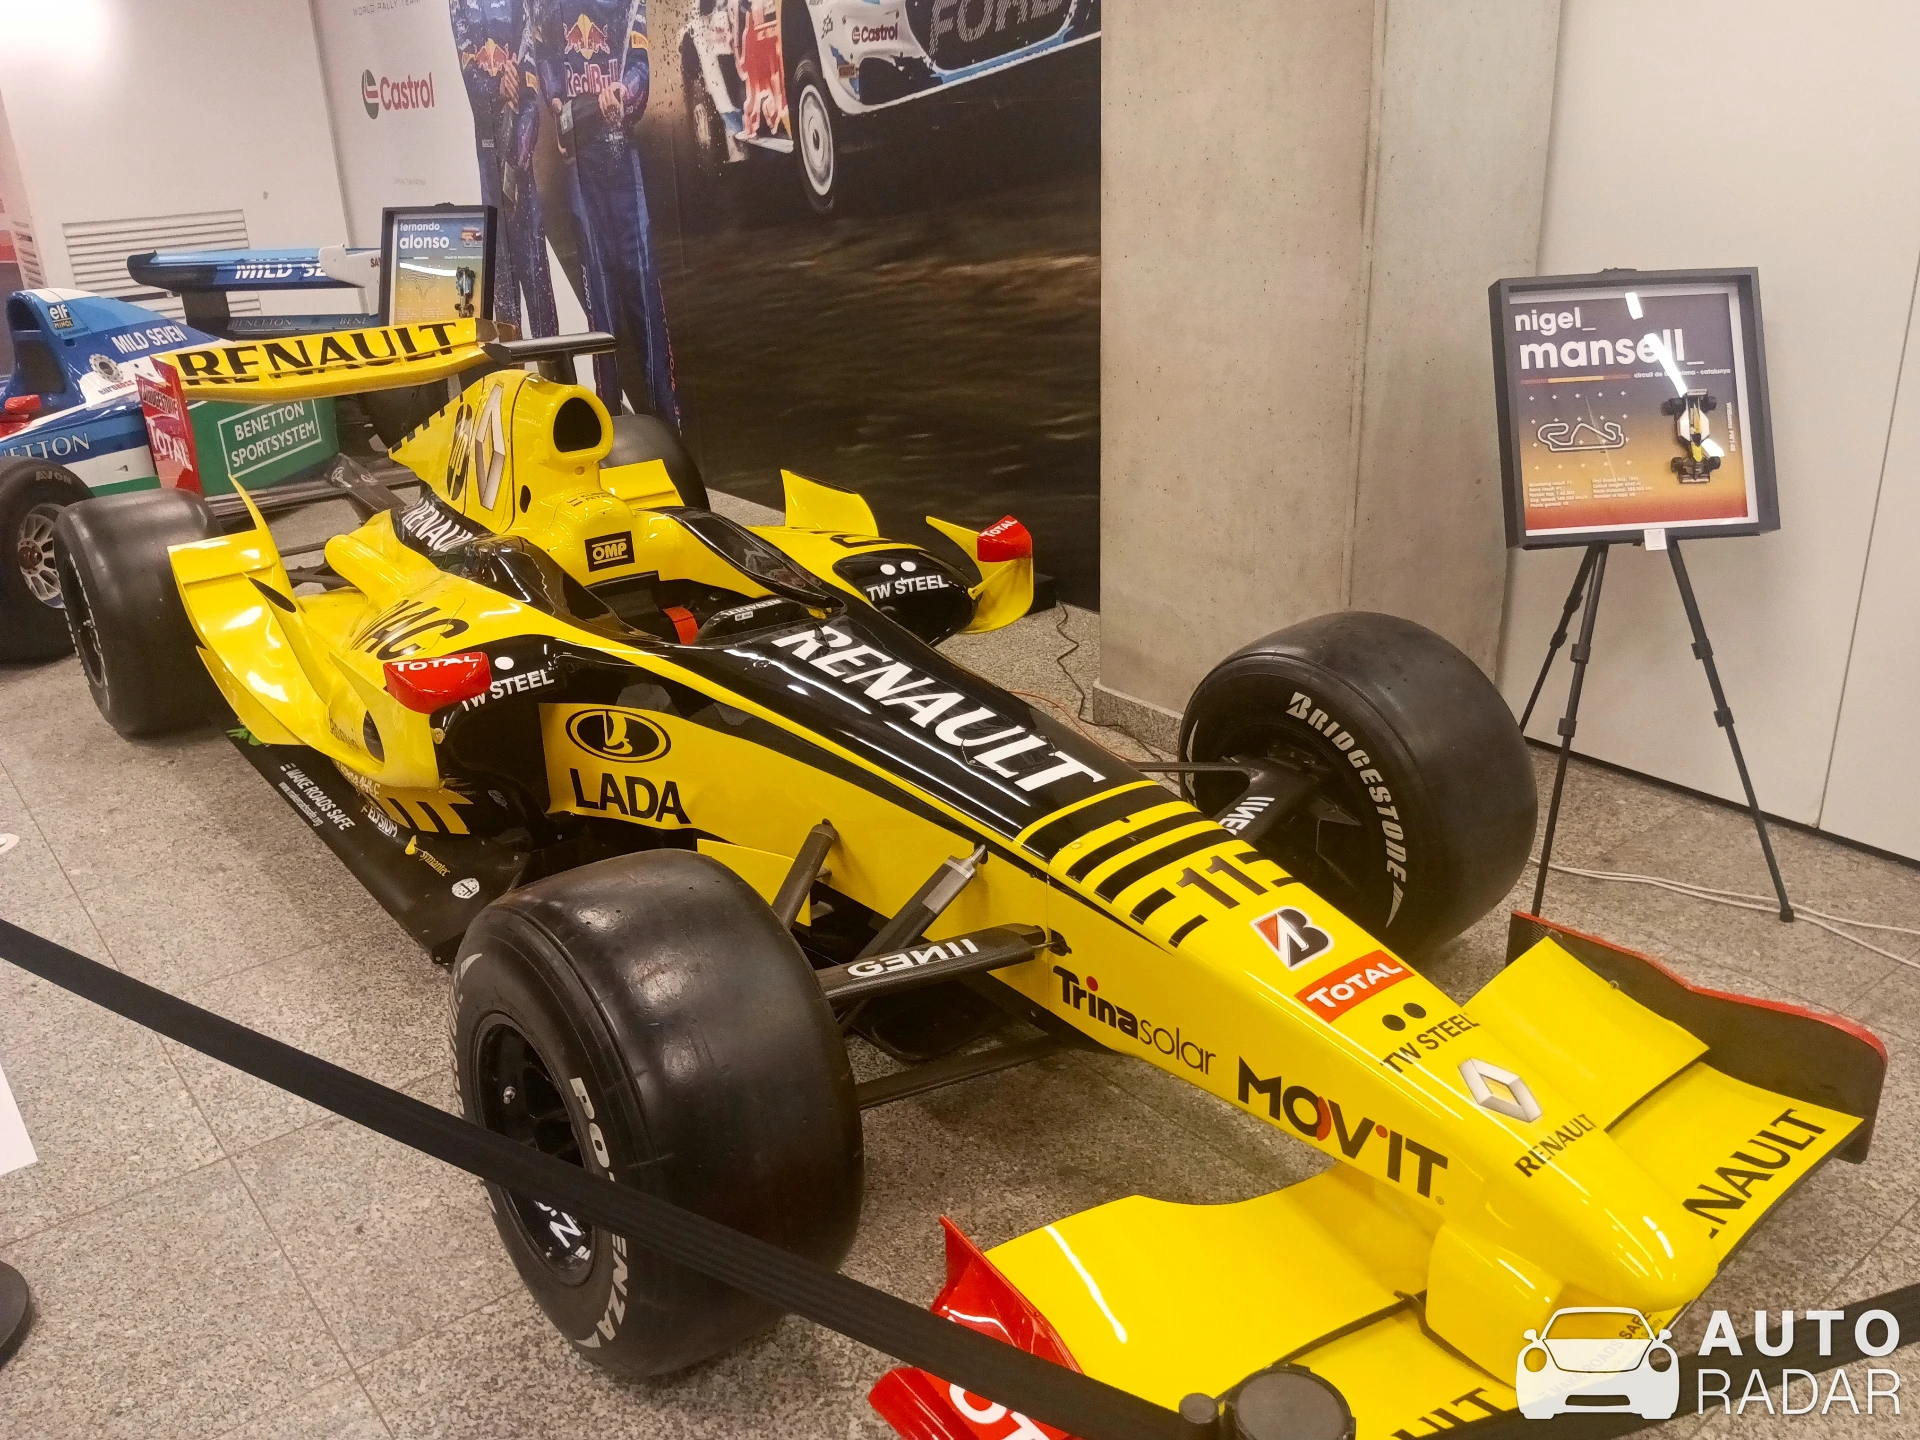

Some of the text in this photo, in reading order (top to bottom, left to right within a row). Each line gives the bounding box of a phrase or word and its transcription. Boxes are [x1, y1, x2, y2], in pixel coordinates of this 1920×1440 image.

[861, 22, 898, 43] Castrol
[380, 72, 435, 111] Castrol
[50, 304, 68, 320] elf
[111, 331, 150, 355] MILD
[148, 325, 188, 347] SEVEN
[176, 322, 457, 386] RENAULT
[234, 402, 305, 442] BENETTON
[3, 432, 90, 458] ETTON
[146, 416, 194, 471] TOTAL
[231, 420, 316, 468] SPORTSYSTEM
[980, 518, 1018, 540] TOTAL
[592, 542, 627, 561] OMP
[866, 574, 949, 602] TW STEEL
[391, 655, 480, 673] TOTAL
[489, 668, 555, 701] STEEL
[771, 625, 1106, 791] RENAULT
[286, 768, 315, 790] MAKE
[304, 785, 337, 812] ROADS
[326, 808, 356, 831] SAFE
[569, 767, 692, 826] LADA
[1286, 691, 1408, 884] BRIDGESTONE
[367, 806, 399, 838] ELYSIUM
[419, 850, 451, 877] symantec
[1306, 959, 1404, 1010] TOTAL
[1380, 1011, 1481, 1076] TW STEEL
[1513, 1113, 1597, 1178] RENAULT
[1682, 1107, 1827, 1240] NAULT
[569, 1077, 629, 1341] POENZA
